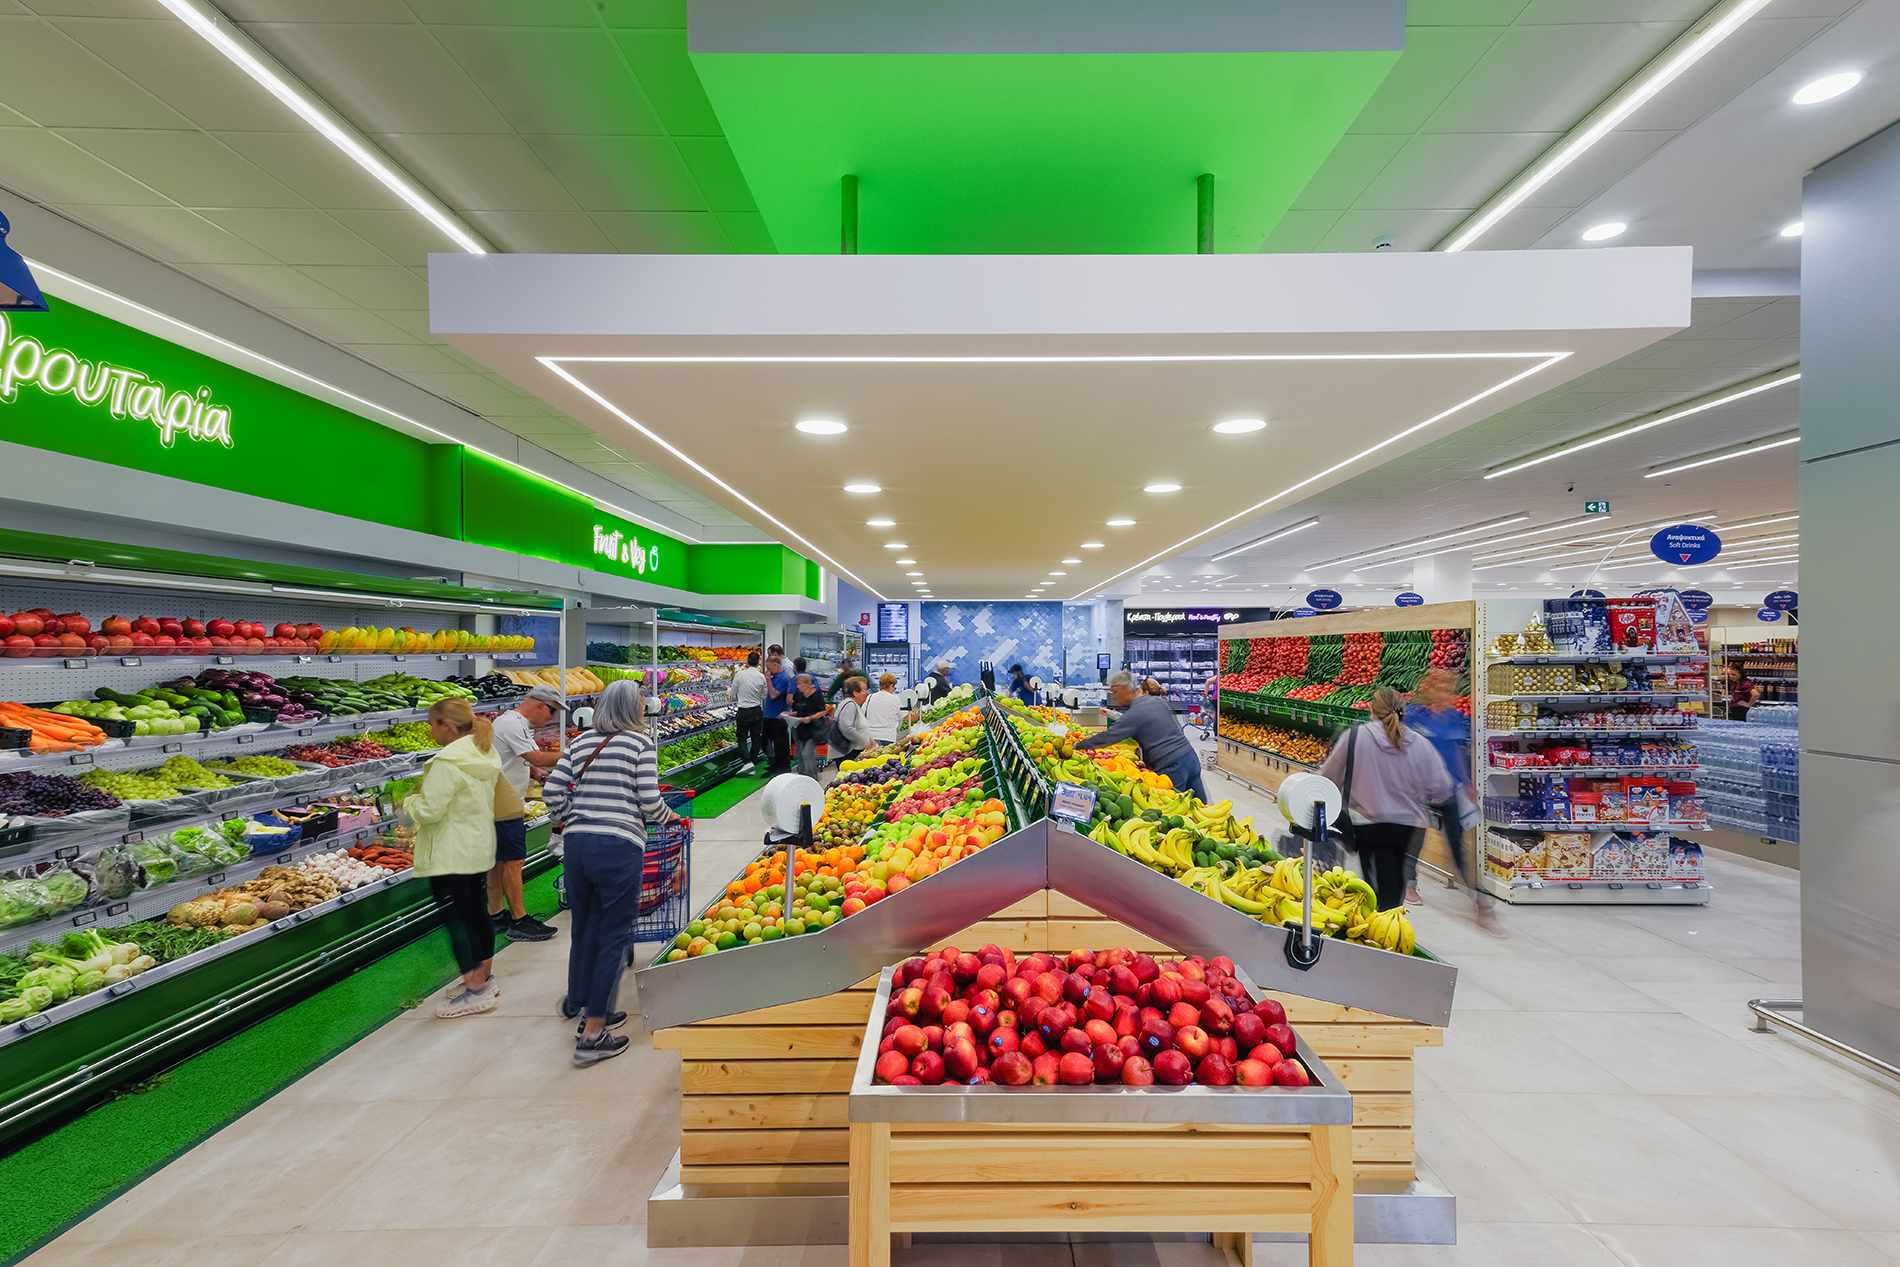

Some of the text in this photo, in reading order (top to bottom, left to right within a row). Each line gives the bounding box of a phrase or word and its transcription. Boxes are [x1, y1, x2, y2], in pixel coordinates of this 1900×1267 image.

[0, 312, 234, 449] ρουταρία
[593, 524, 624, 561] Fruit
[630, 537, 647, 576] Veg
[1667, 534, 1705, 542] Αναψυκτικά
